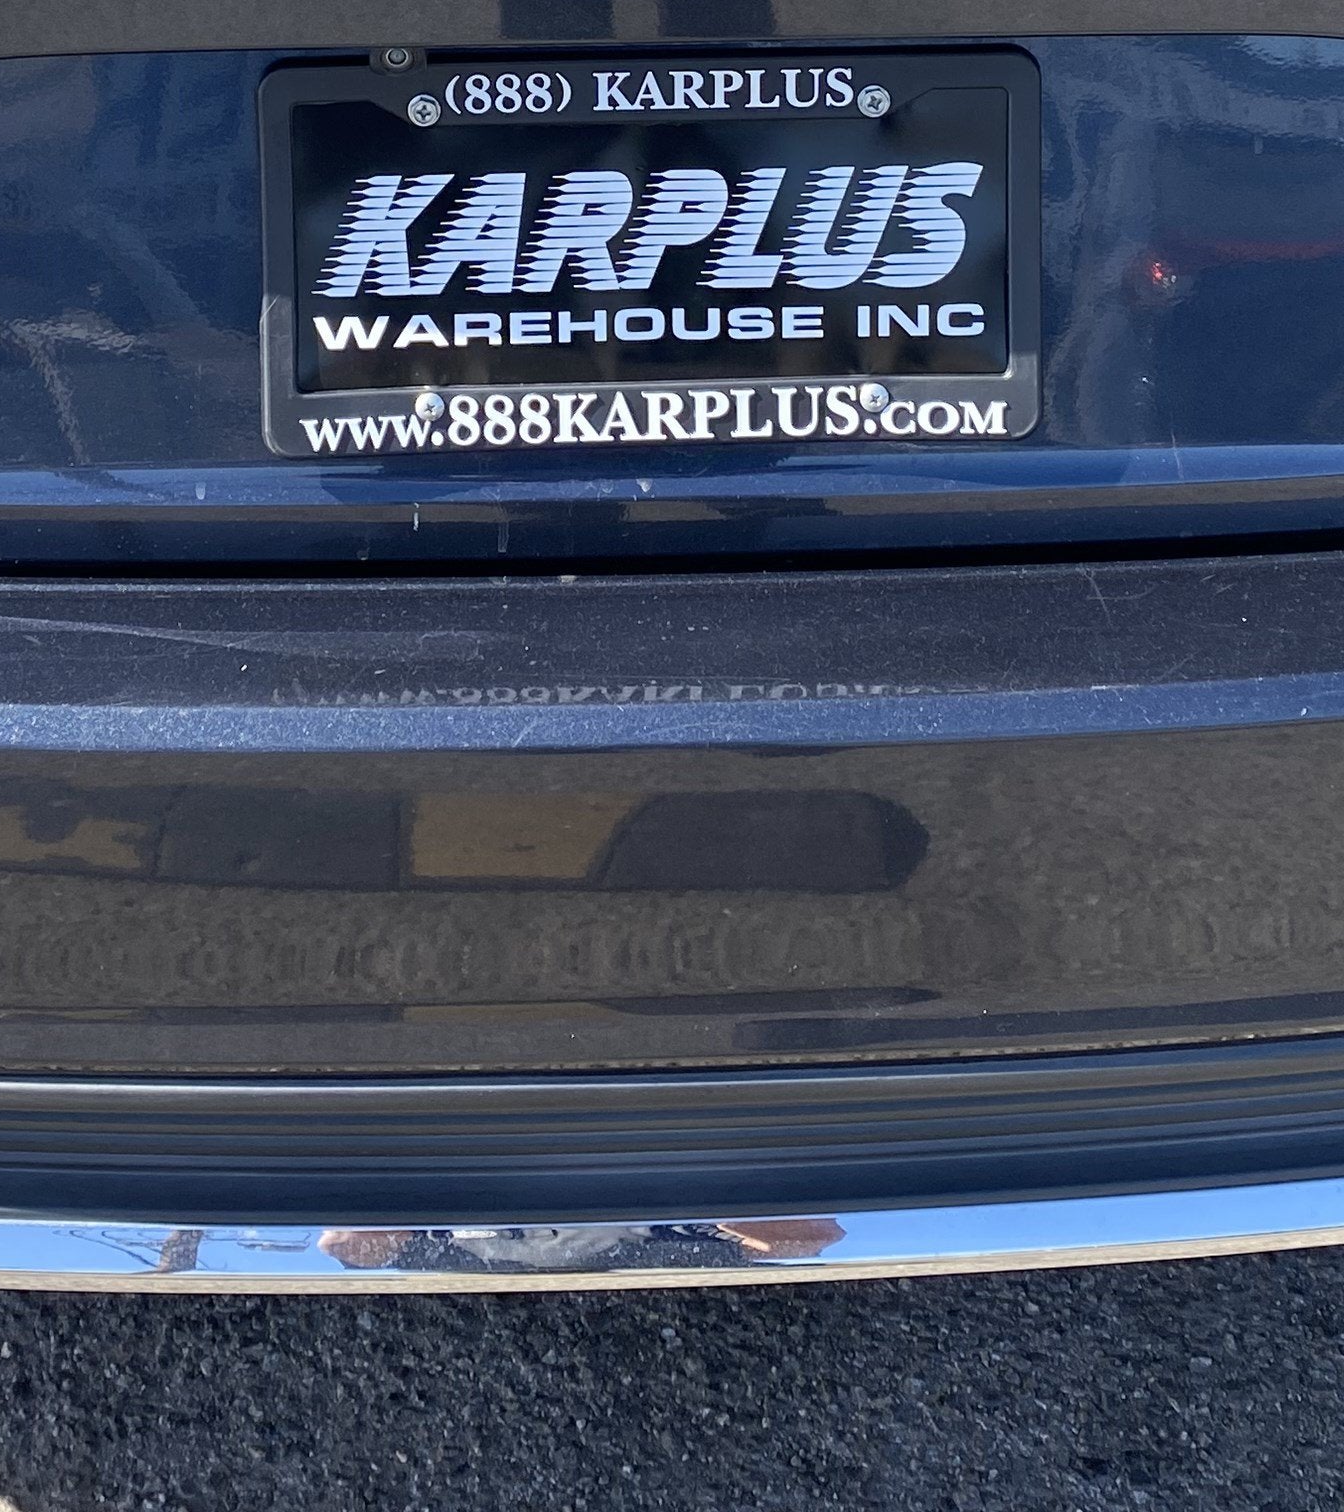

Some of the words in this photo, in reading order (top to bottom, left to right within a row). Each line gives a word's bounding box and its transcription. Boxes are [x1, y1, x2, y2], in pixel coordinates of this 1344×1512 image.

[444, 72, 573, 115] (888)
[592, 67, 855, 112] KARPLUS
[311, 161, 984, 298] KARPLUS
[313, 306, 825, 351] WAREHOUSE
[857, 303, 985, 339] INC
